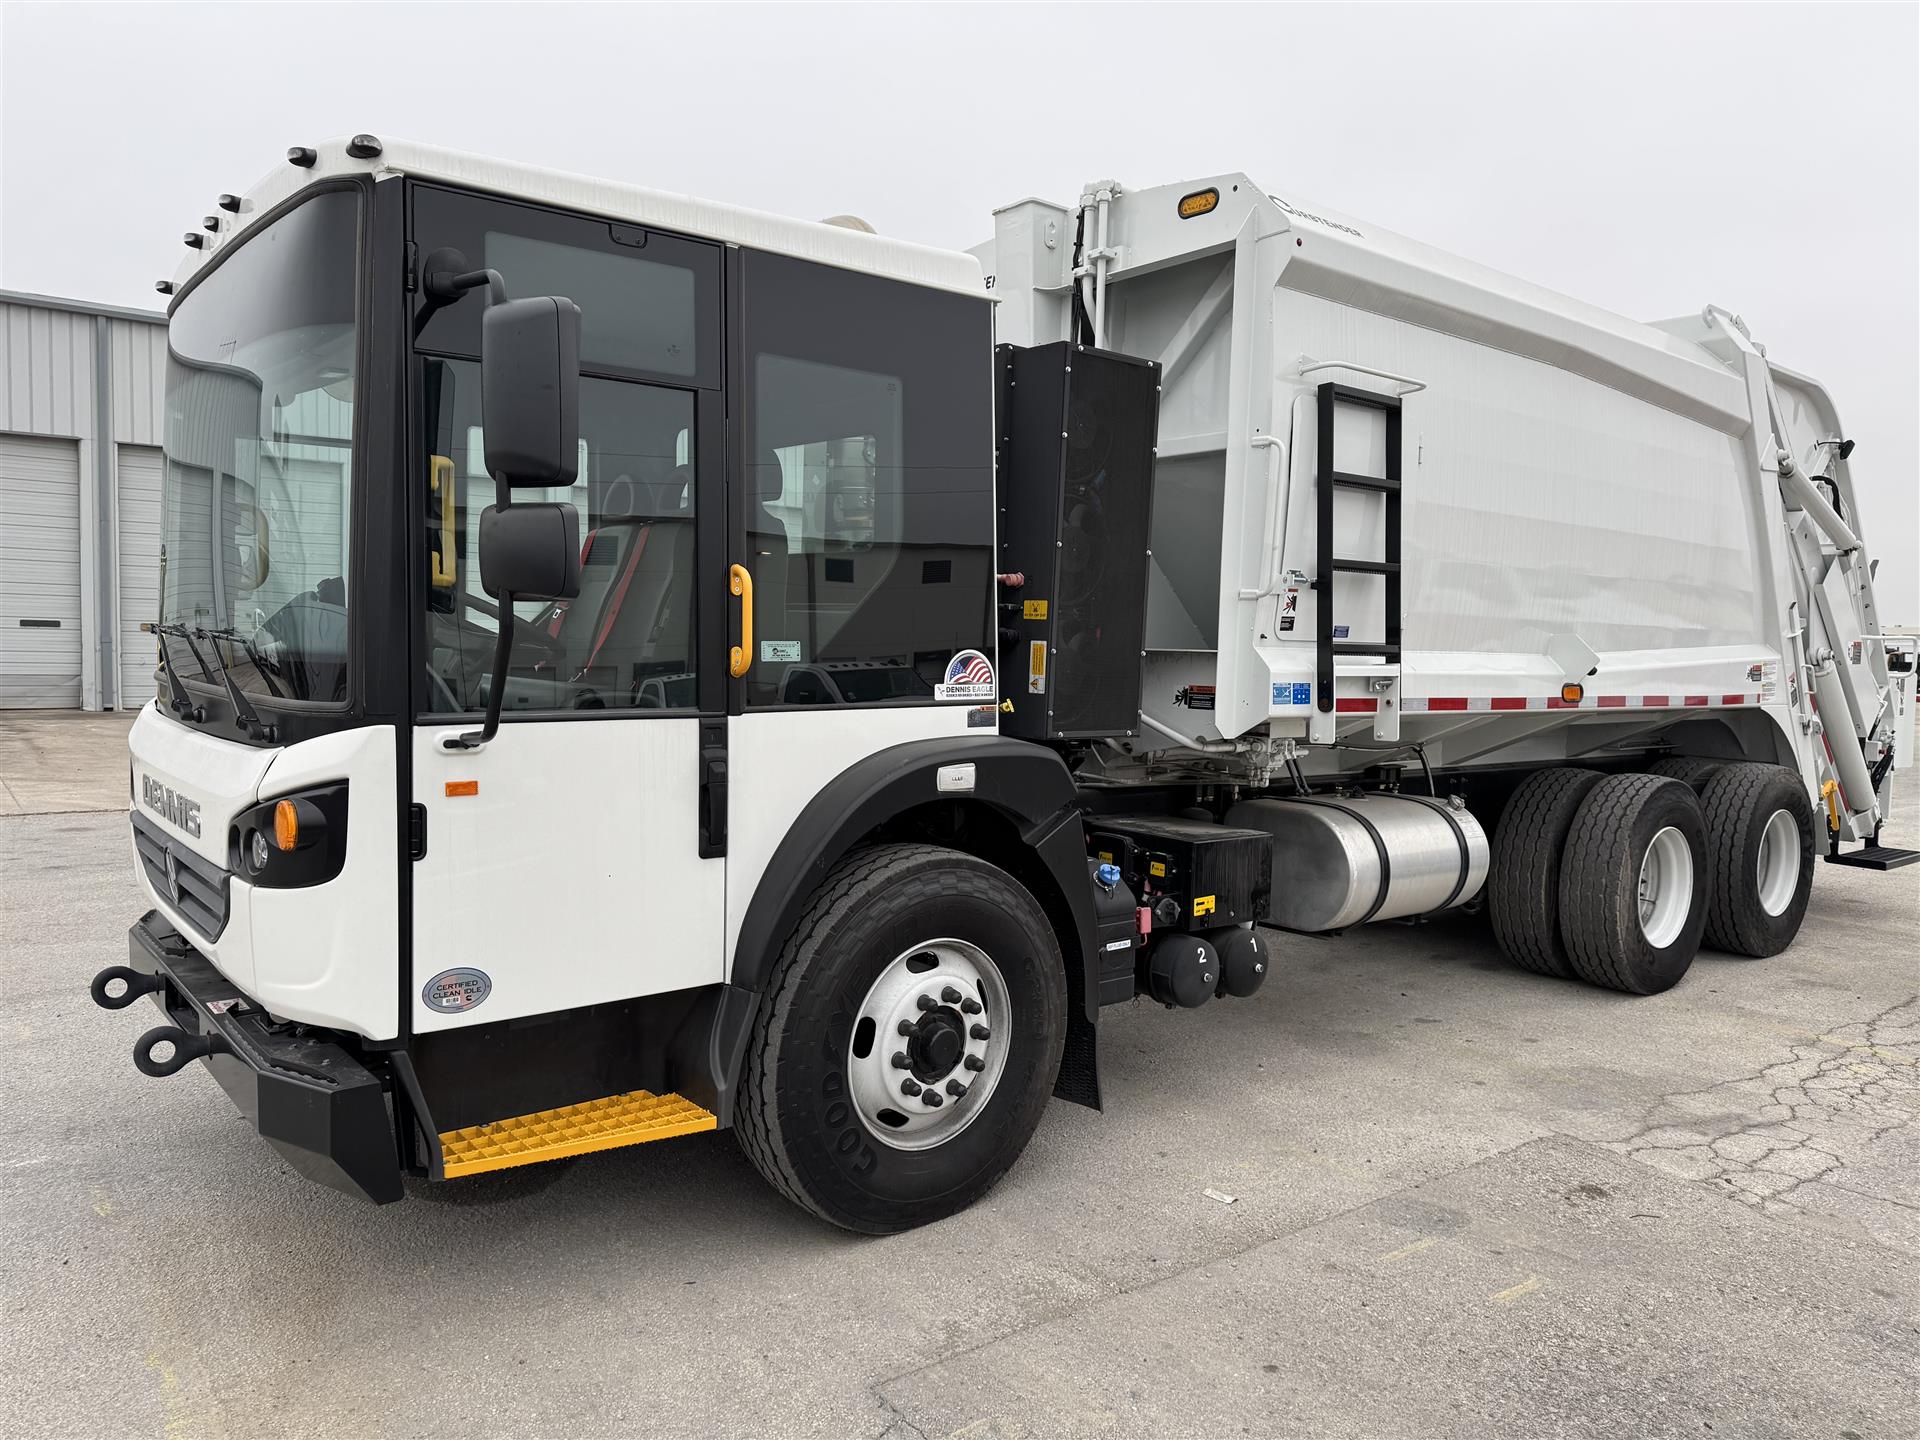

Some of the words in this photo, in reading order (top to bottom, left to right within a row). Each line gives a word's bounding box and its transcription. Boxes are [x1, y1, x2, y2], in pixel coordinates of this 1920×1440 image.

[946, 685, 971, 693] DENNIS
[142, 772, 201, 840] DENNIS
[1250, 937, 1258, 952] 1
[1197, 947, 1207, 964] 2
[436, 979, 479, 991] CERTIFIED
[432, 989, 461, 1000] CLEAN
[463, 986, 482, 995] IDLE
